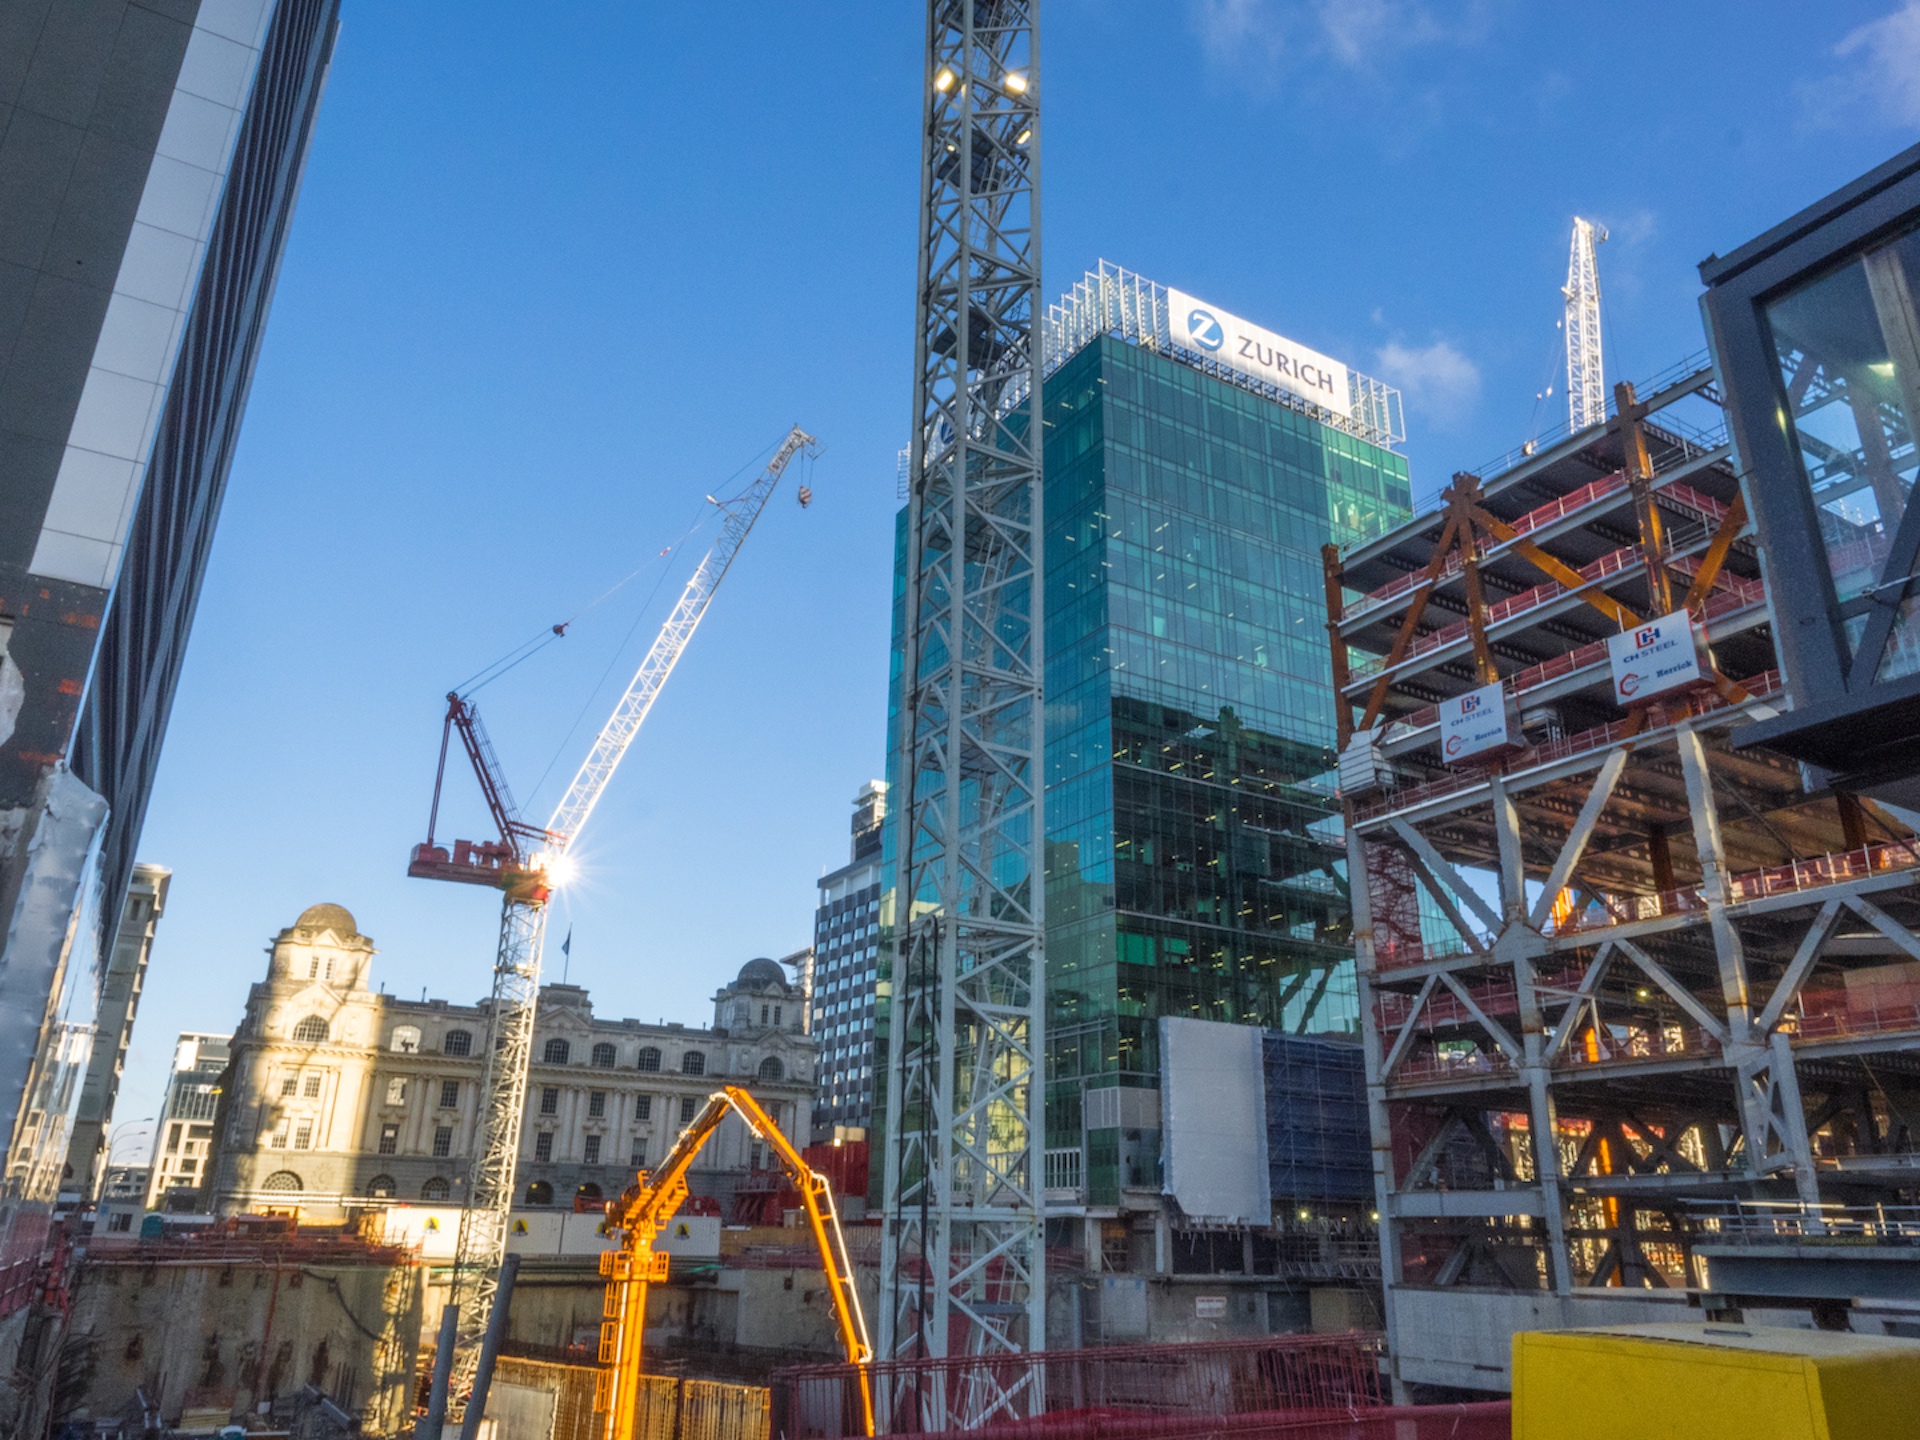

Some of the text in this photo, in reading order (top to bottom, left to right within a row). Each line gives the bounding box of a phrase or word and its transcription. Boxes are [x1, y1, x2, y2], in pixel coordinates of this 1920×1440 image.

[1191, 312, 1334, 394] Z ZURICH
[1623, 640, 1678, 664] CH STEEL
[1451, 707, 1494, 727] CH STEEL
